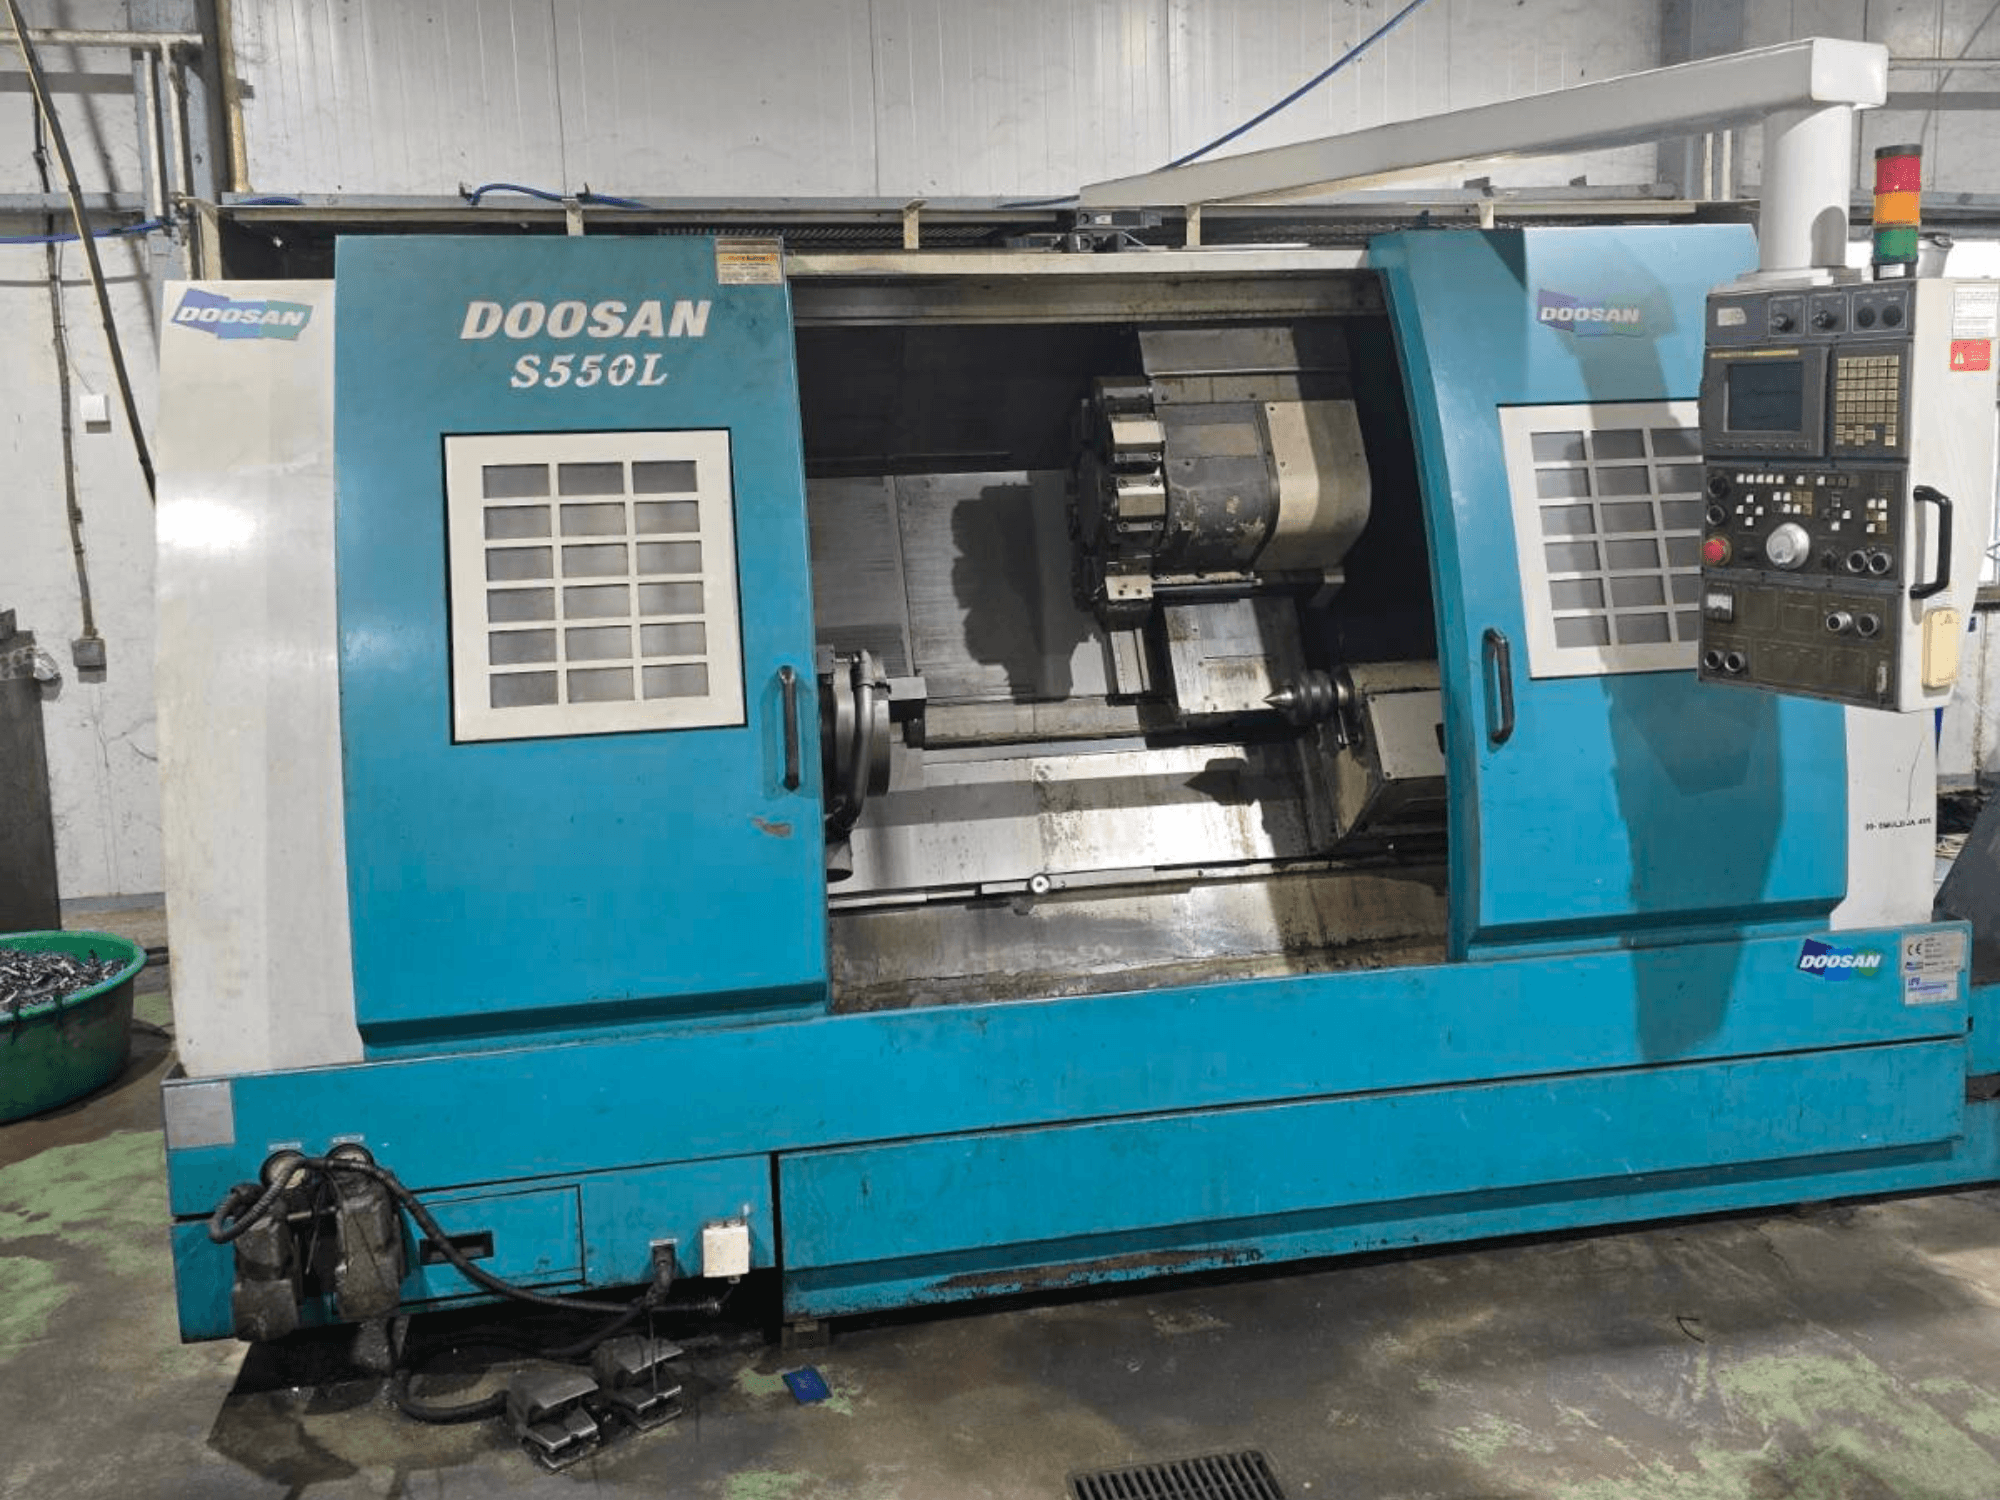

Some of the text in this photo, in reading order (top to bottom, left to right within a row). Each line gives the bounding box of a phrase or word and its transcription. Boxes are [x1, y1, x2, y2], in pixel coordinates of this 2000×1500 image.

[176, 306, 306, 326] DOOSAN
[459, 300, 712, 340] DOOSAN
[1540, 306, 1641, 324] DOOSAN
[510, 353, 668, 388] S550L
[1799, 954, 1882, 969] DOOSAN
